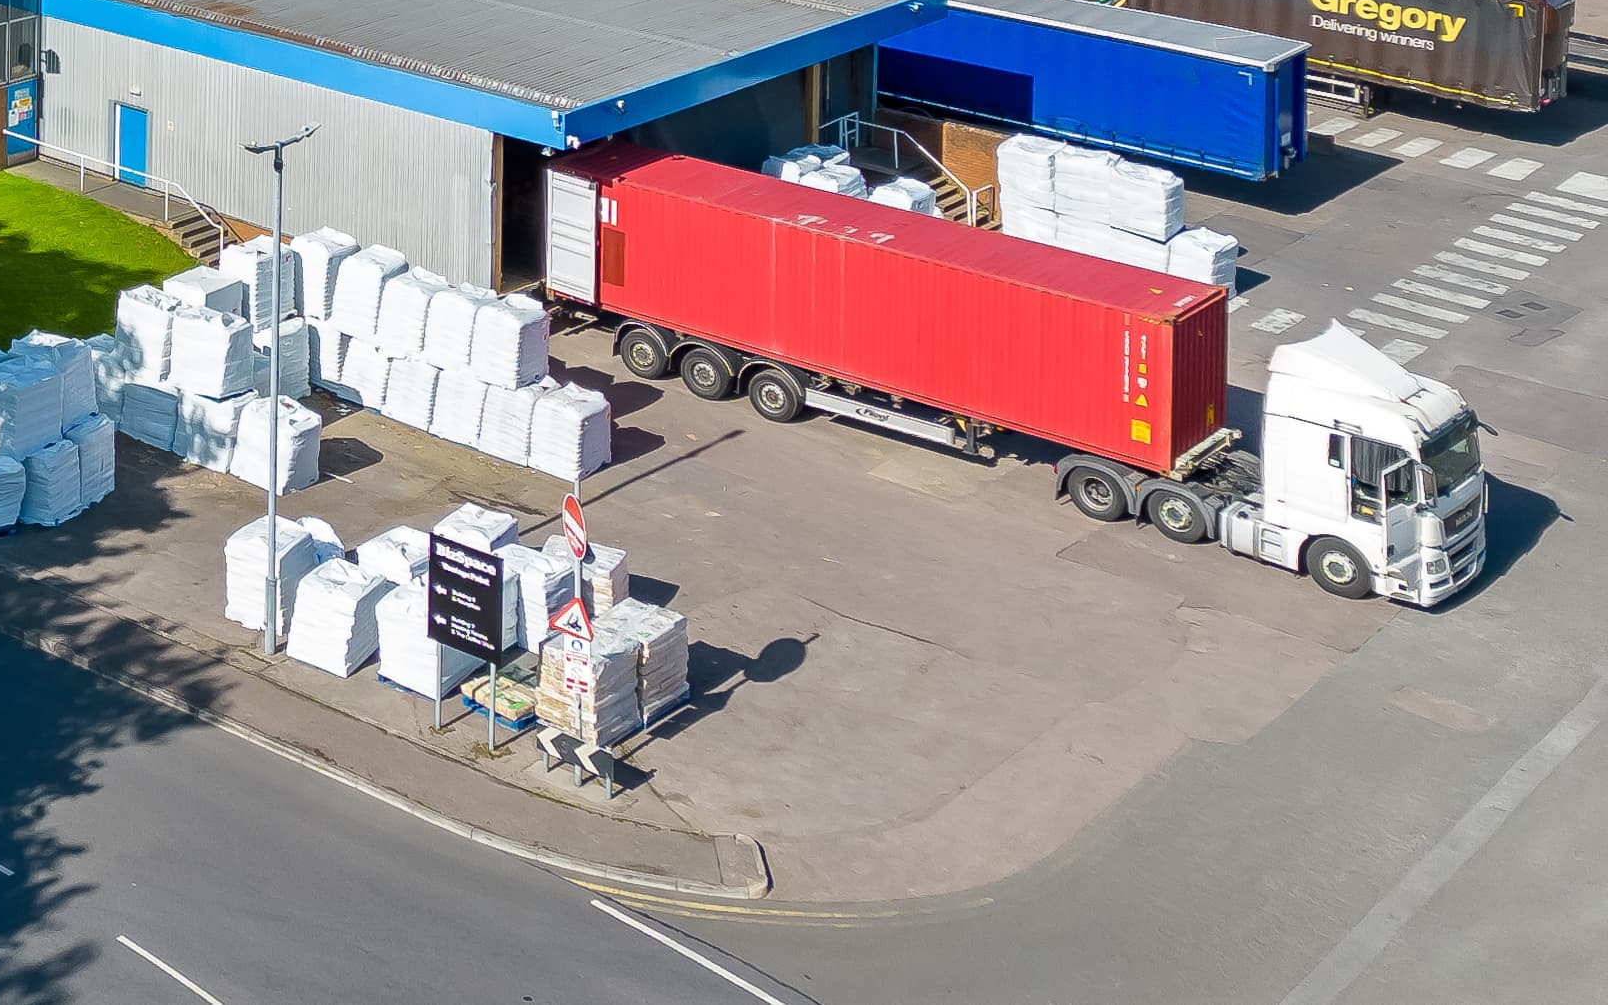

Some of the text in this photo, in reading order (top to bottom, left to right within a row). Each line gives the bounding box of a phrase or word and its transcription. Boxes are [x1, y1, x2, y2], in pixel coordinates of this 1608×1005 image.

[1311, 14, 1435, 51] Delivering winners
[435, 542, 497, 576] BizSpace
